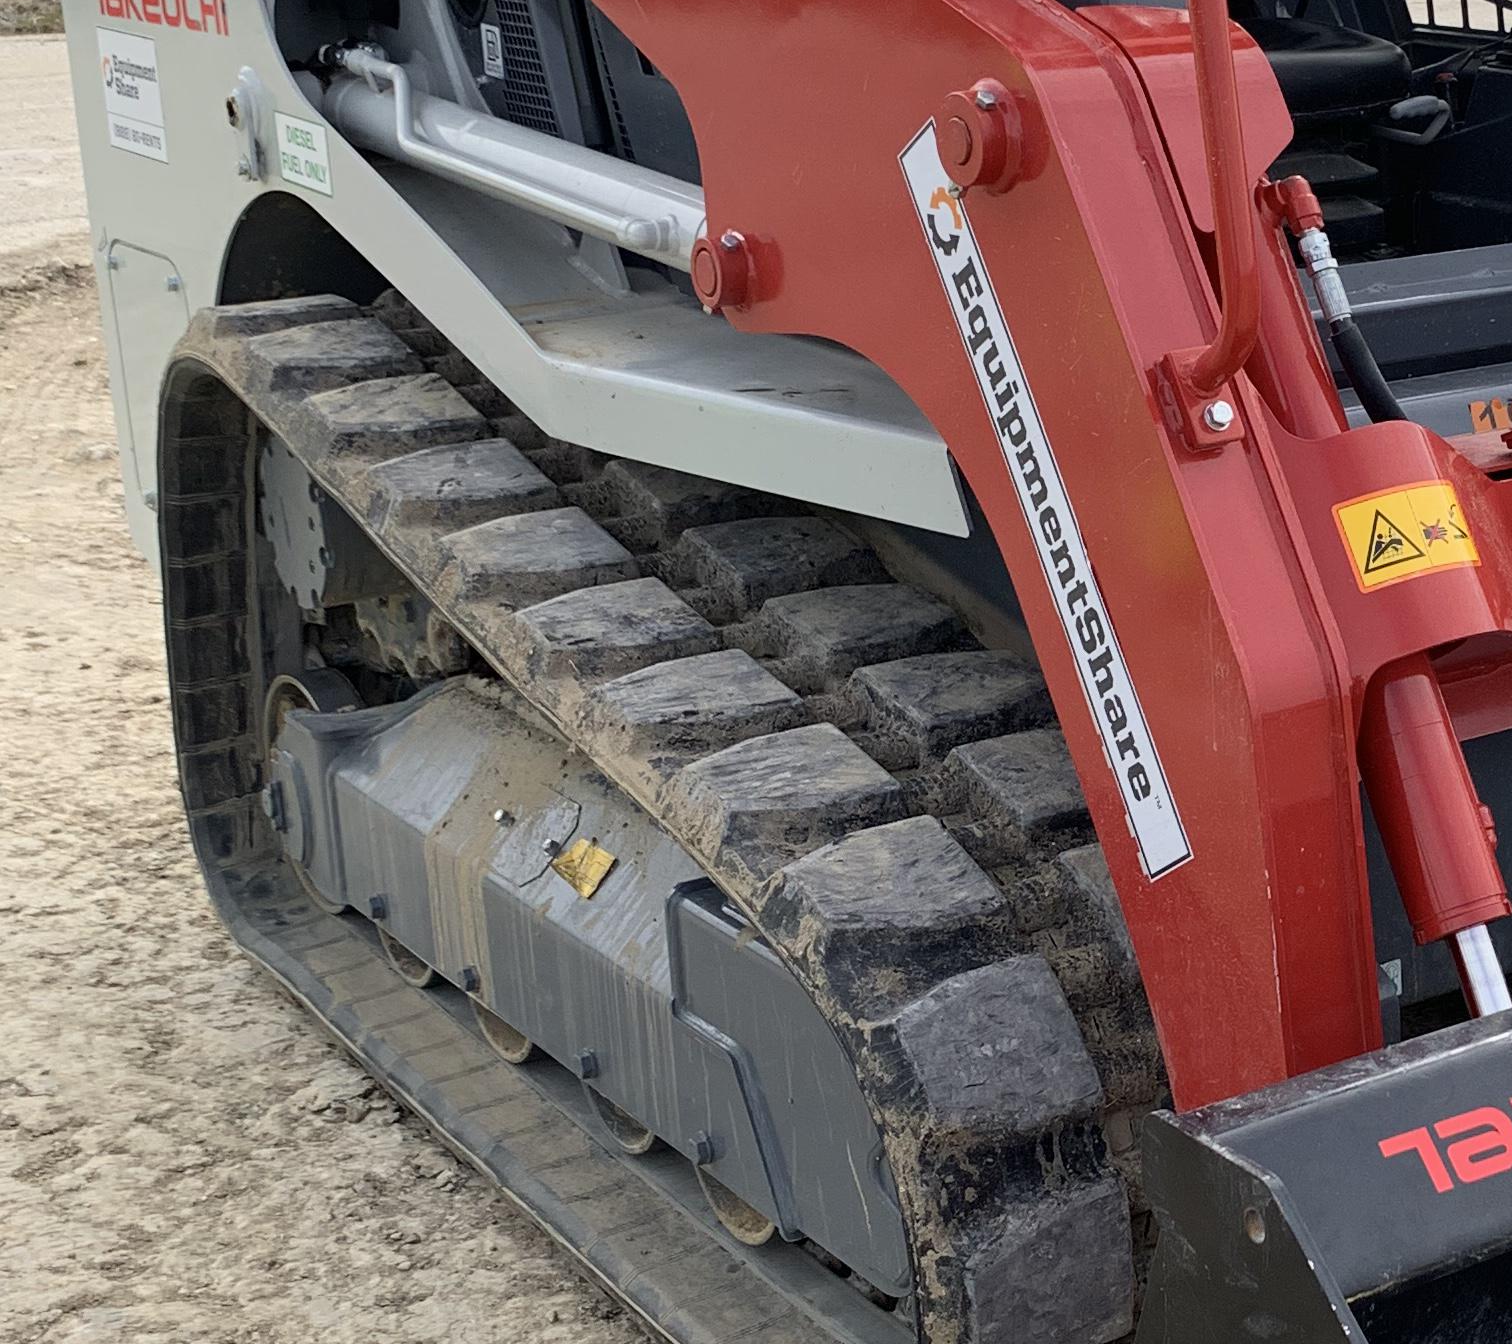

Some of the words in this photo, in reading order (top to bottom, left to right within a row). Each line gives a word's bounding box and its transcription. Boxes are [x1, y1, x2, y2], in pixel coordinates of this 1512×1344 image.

[285, 124, 317, 152] DIESEL
[281, 151, 304, 176] FUEL
[304, 159, 327, 185] ONLY
